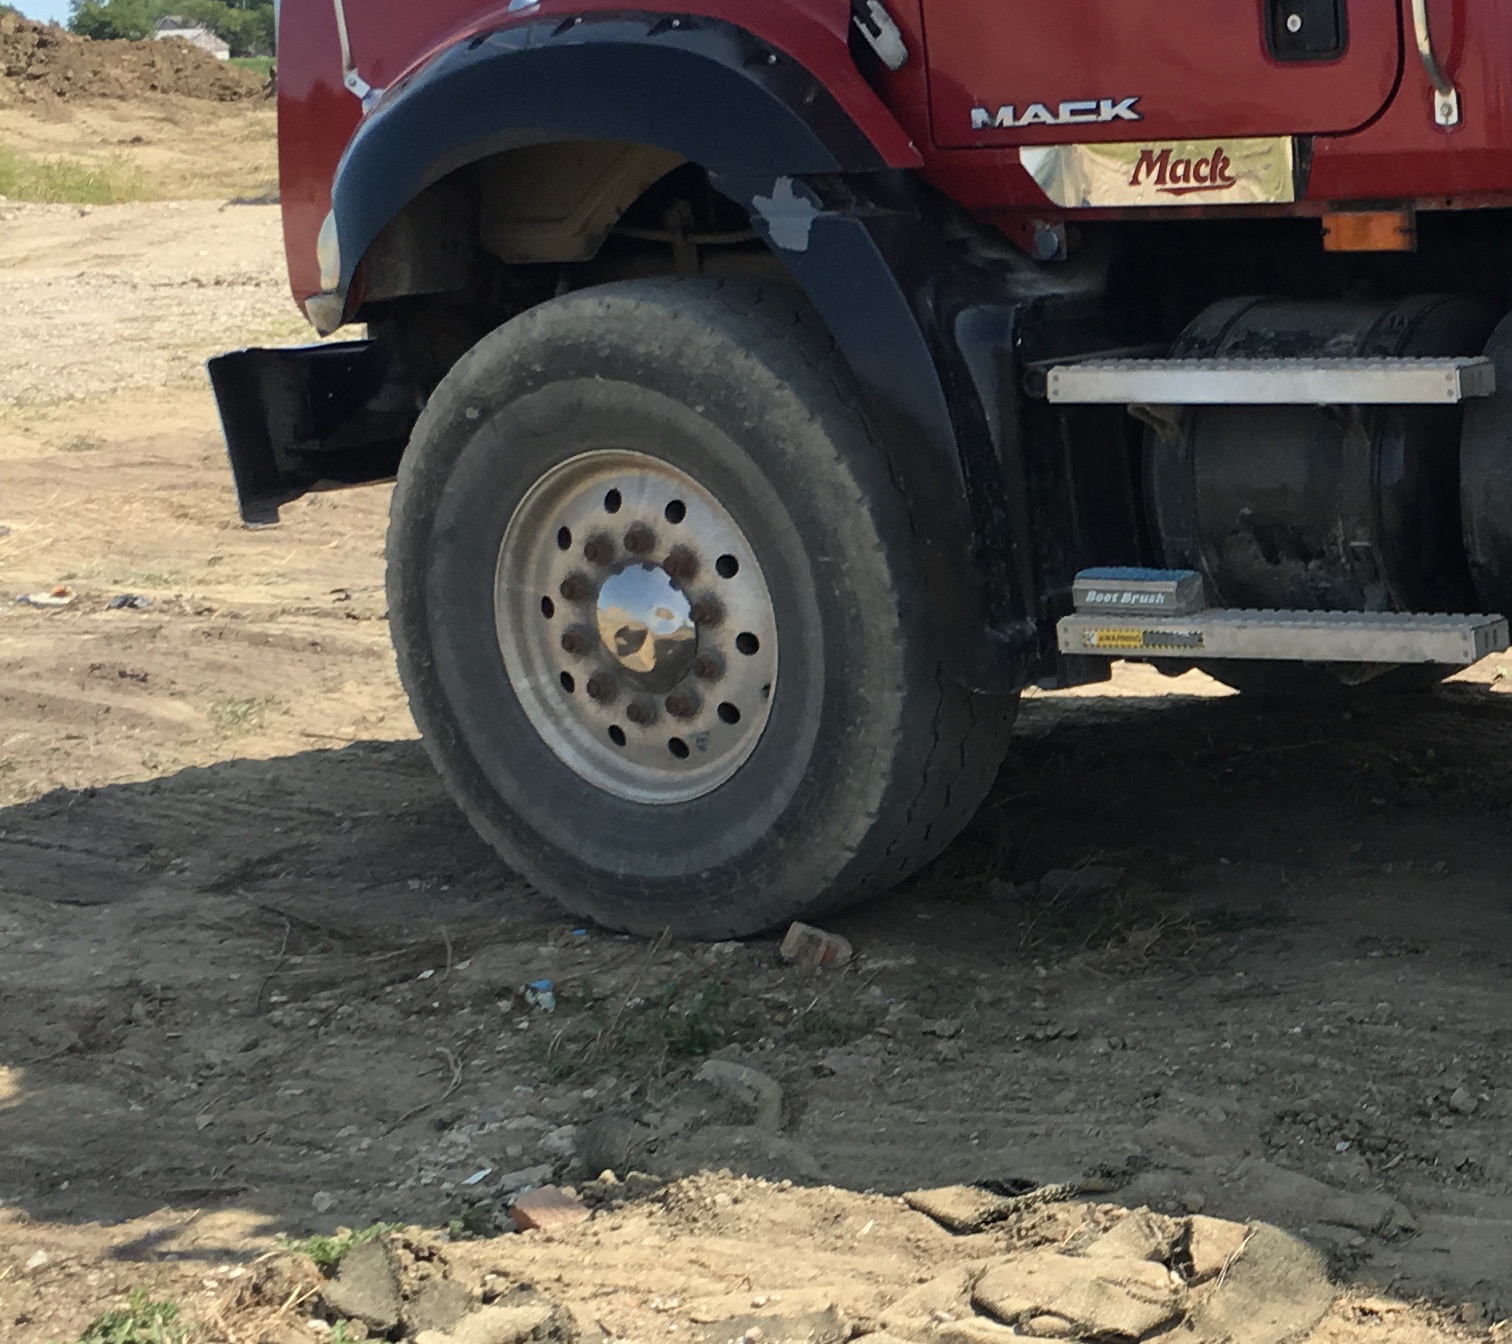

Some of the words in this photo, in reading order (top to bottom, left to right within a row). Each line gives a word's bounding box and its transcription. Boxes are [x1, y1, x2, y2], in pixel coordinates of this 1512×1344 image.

[971, 96, 1143, 130] MACK
[1128, 146, 1237, 196] Mack
[1085, 590, 1119, 603] Boot
[1121, 592, 1165, 605] Brush
